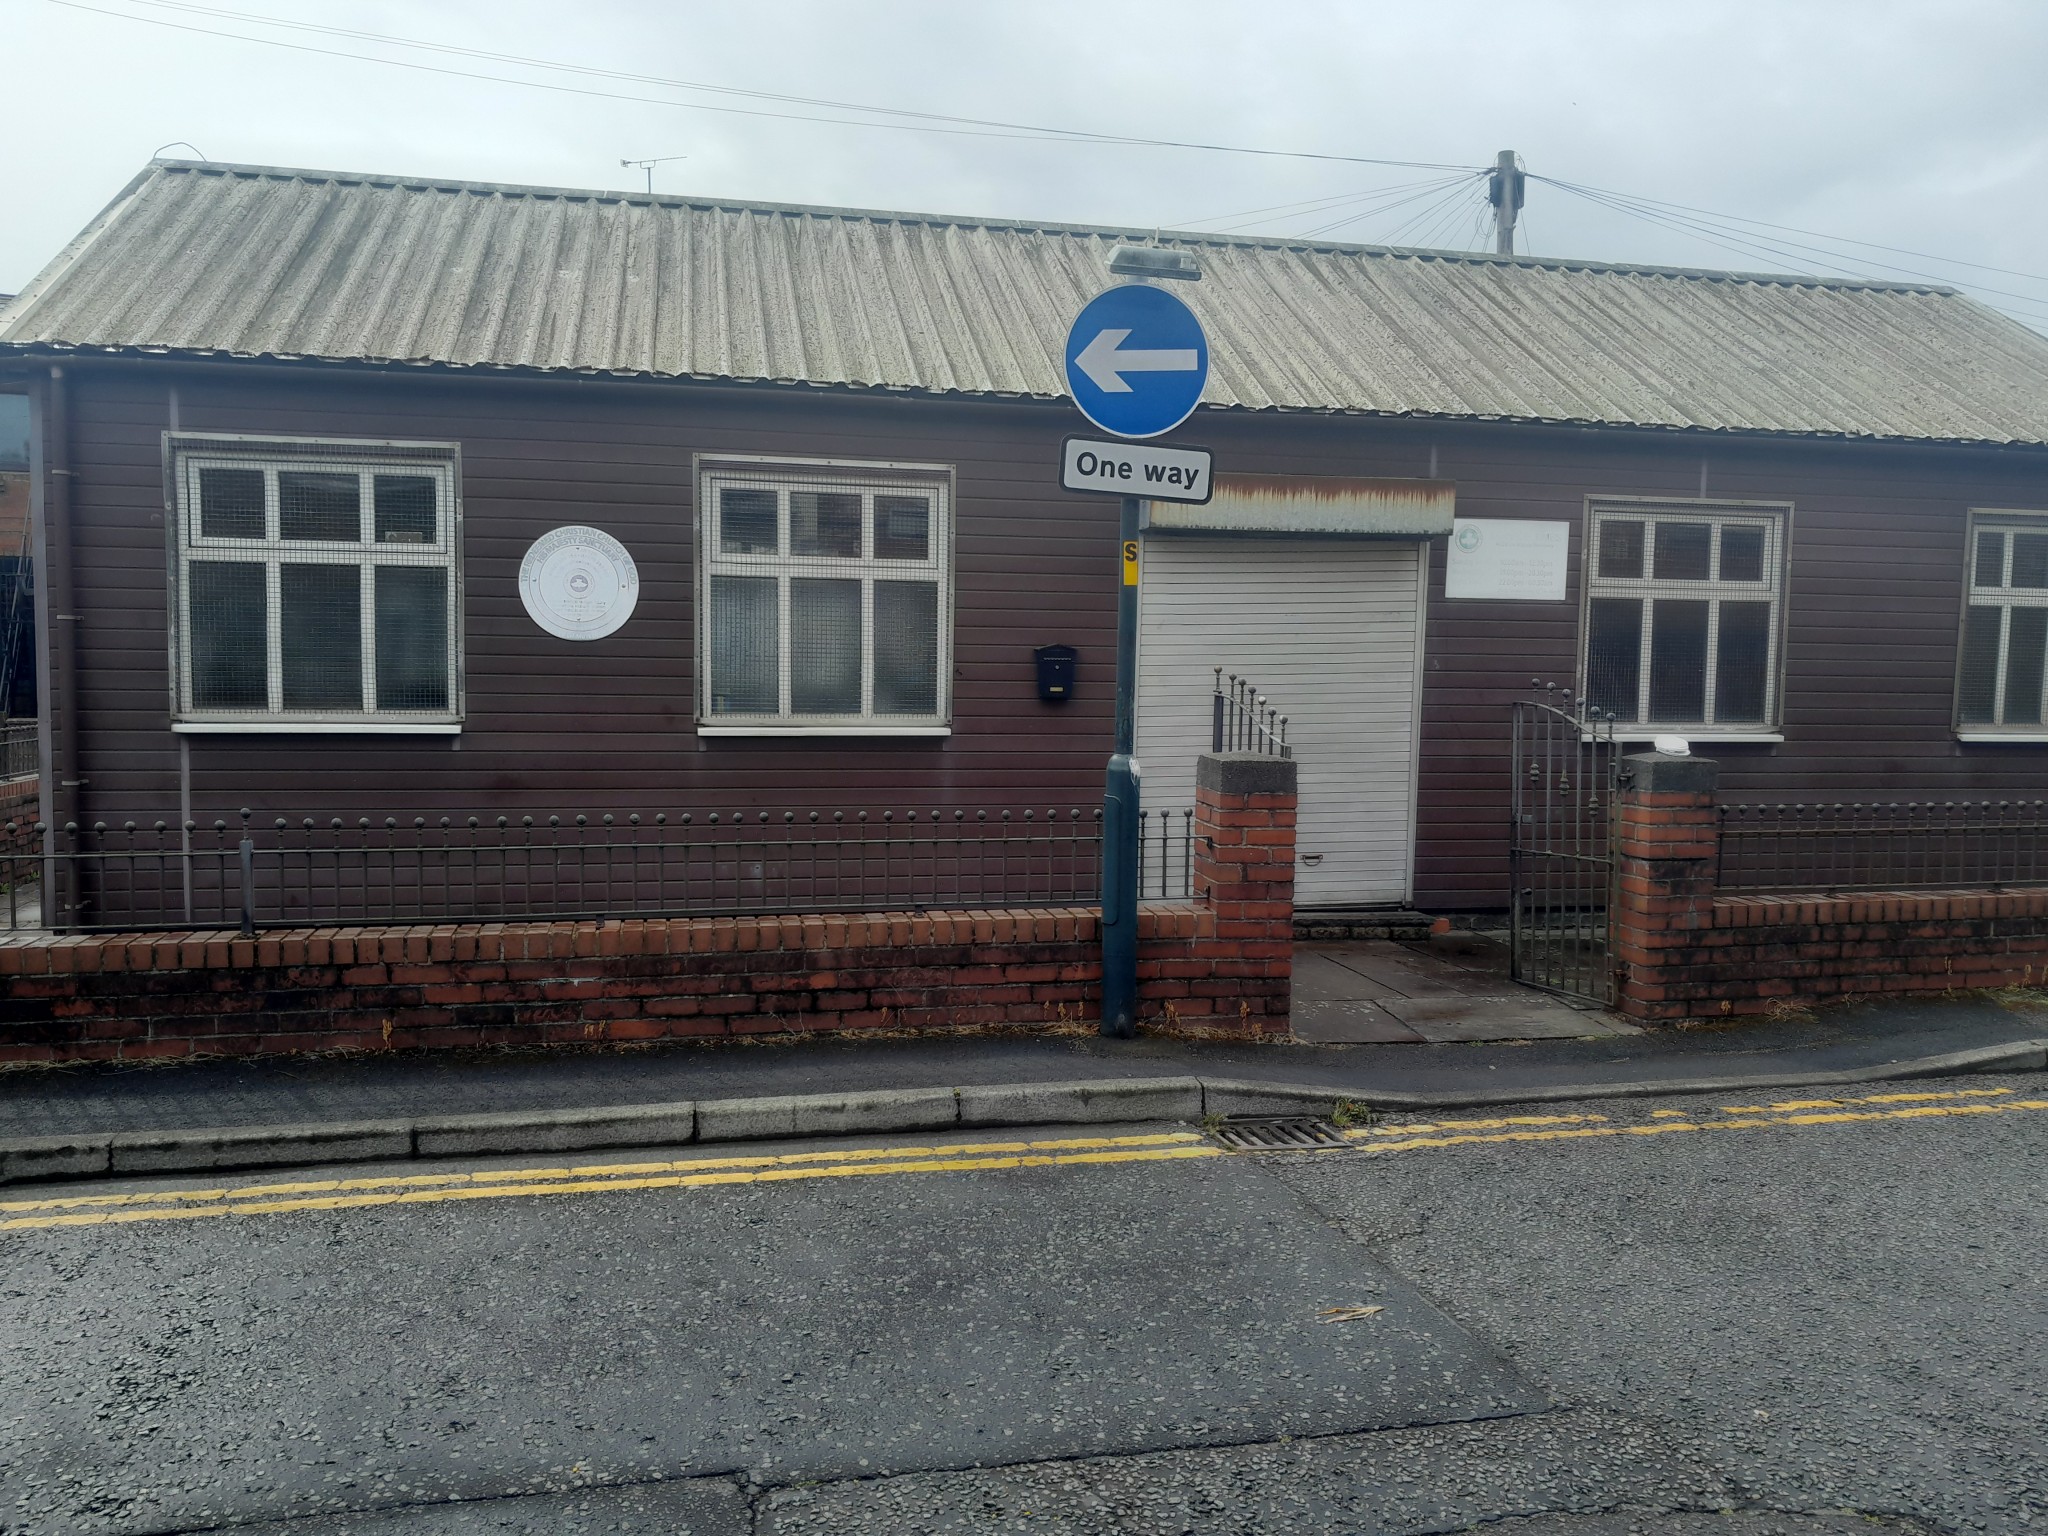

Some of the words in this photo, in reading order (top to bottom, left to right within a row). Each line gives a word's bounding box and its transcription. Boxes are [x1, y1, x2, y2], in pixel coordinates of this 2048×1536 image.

[1076, 451, 1133, 480] One
[1144, 463, 1200, 491] way
[520, 567, 529, 583] THE
[555, 527, 597, 538] CHRISTIAN
[597, 533, 625, 557] CHURCH
[627, 567, 637, 585] GOD
[545, 537, 578, 556] MAJESTY
[578, 537, 619, 562] SANCTUARY
[1124, 543, 1137, 562] S
